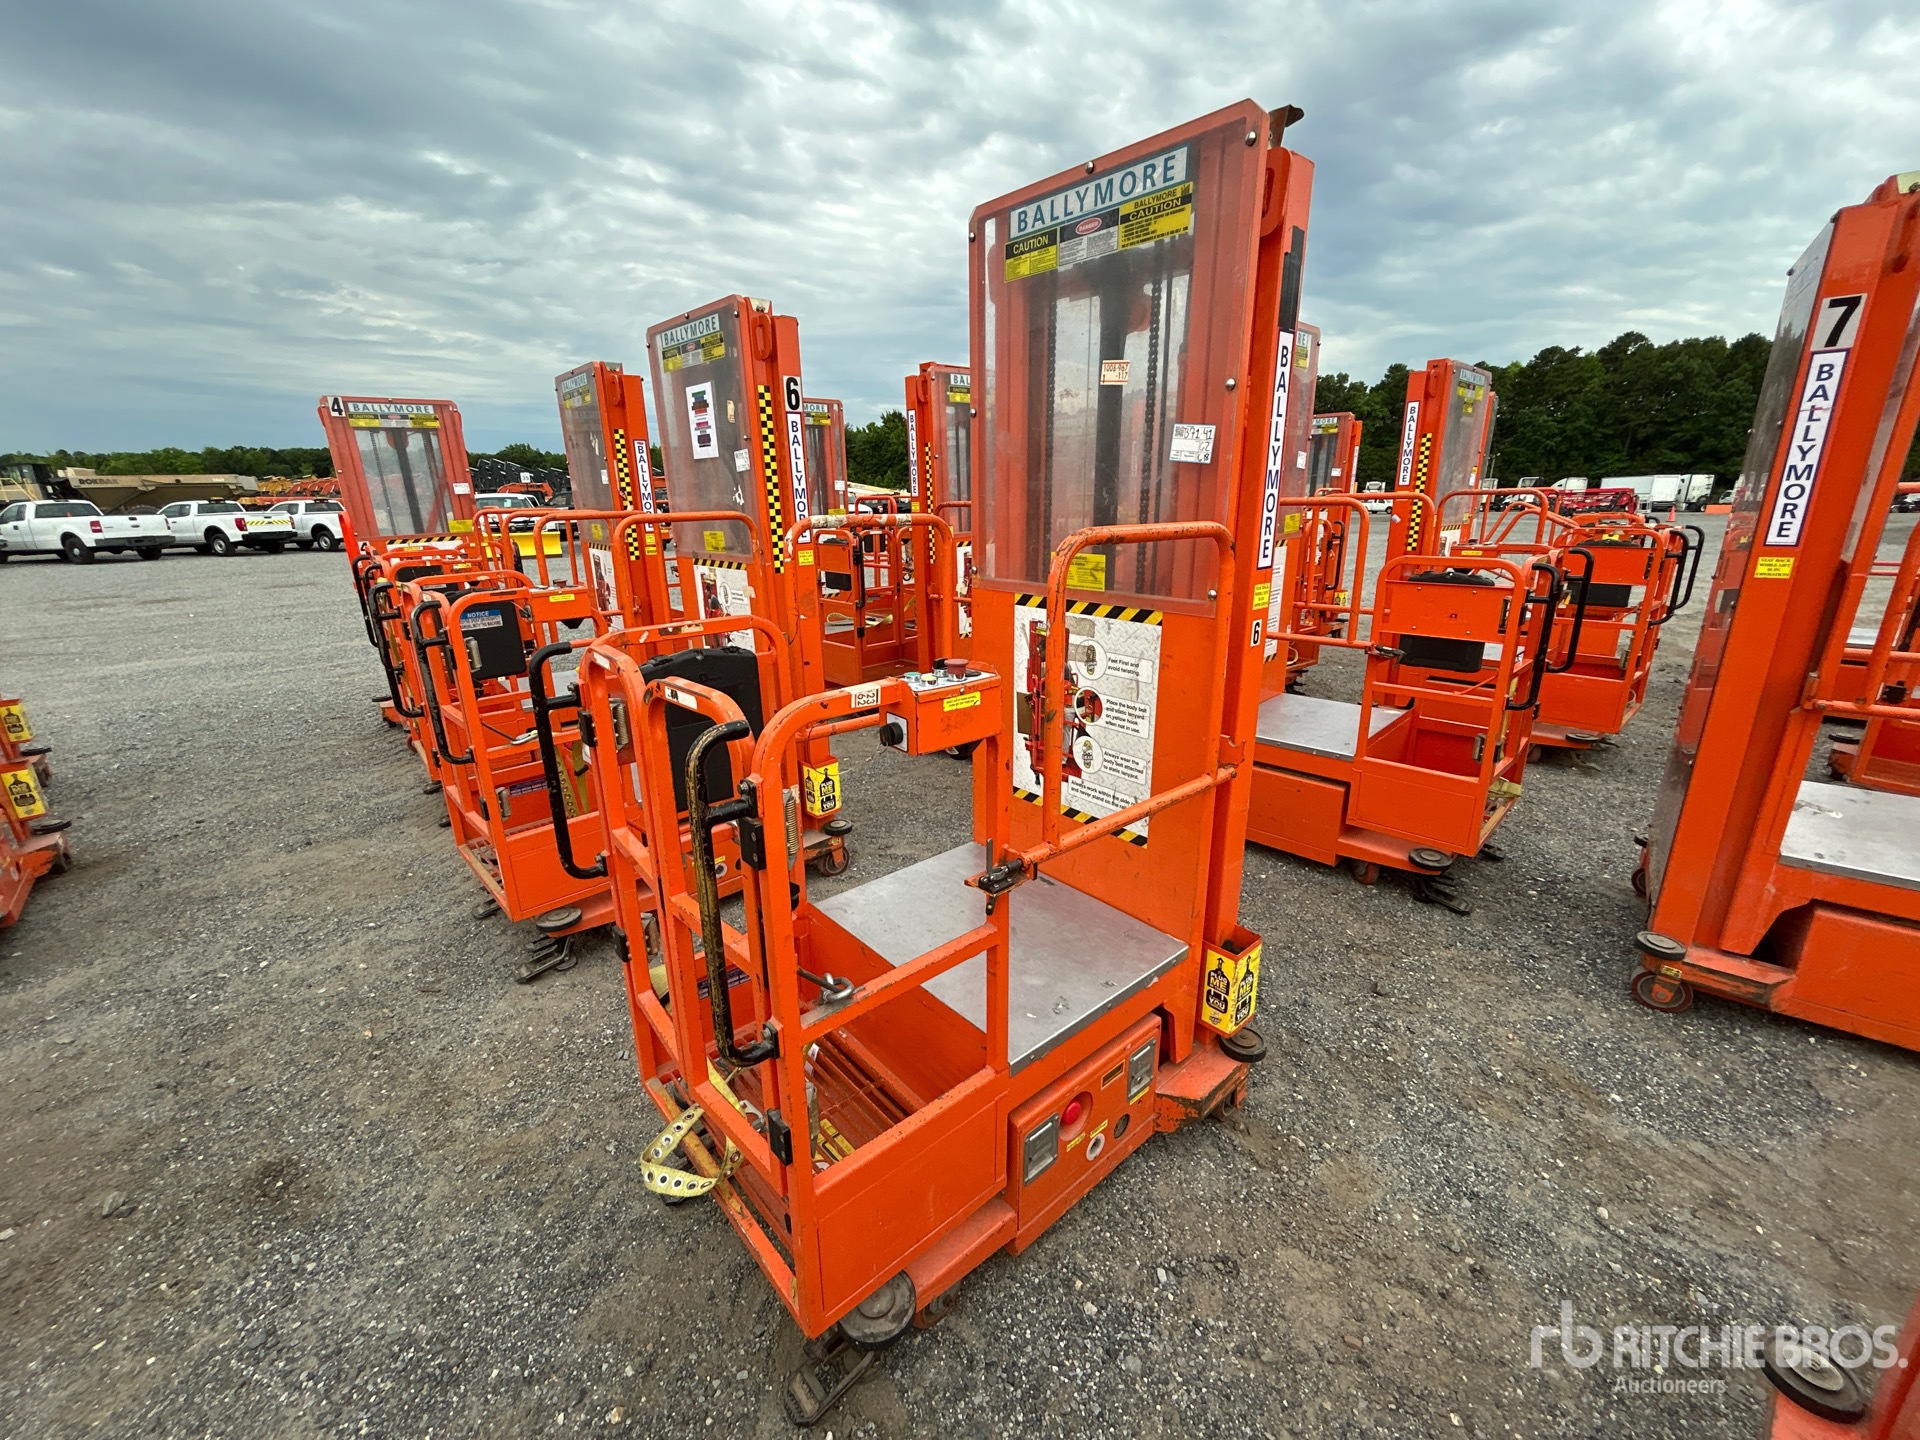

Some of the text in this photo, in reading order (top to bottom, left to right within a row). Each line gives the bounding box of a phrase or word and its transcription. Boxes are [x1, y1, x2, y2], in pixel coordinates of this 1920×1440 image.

[1016, 153, 1177, 233] BALLYMORE
[1134, 189, 1177, 209] BALLYMORE
[1129, 197, 1181, 221] CAUTION
[1013, 234, 1048, 255] CAUTION
[664, 316, 716, 345] BALLYMORE
[1823, 295, 1862, 348] 7
[786, 376, 800, 410] 6
[331, 397, 343, 416] 4
[353, 403, 431, 413] BALLYMORE
[1263, 345, 1289, 559] BALLYMORE
[1402, 407, 1416, 483] BALLYMORE
[1776, 363, 1833, 538] BALLYMORE
[638, 446, 653, 530] BALLYMOE
[467, 610, 490, 618] NOTICE
[1253, 621, 1260, 645] 6
[1127, 702, 1138, 711] body
[1112, 714, 1126, 723] yellow
[1104, 750, 1119, 760] Always
[1103, 757, 1114, 766] body
[1124, 765, 1144, 775] attached
[821, 784, 833, 796] ME
[1071, 780, 1086, 789] Always
[1098, 789, 1112, 798] within
[1092, 793, 1104, 802] stand
[823, 801, 834, 809] YOU
[1209, 977, 1227, 991] ME
[1211, 971, 1228, 983] PLUG
[1240, 981, 1252, 994] ME
[1209, 995, 1226, 1009] YOU
[1237, 1004, 1250, 1019] YOU
